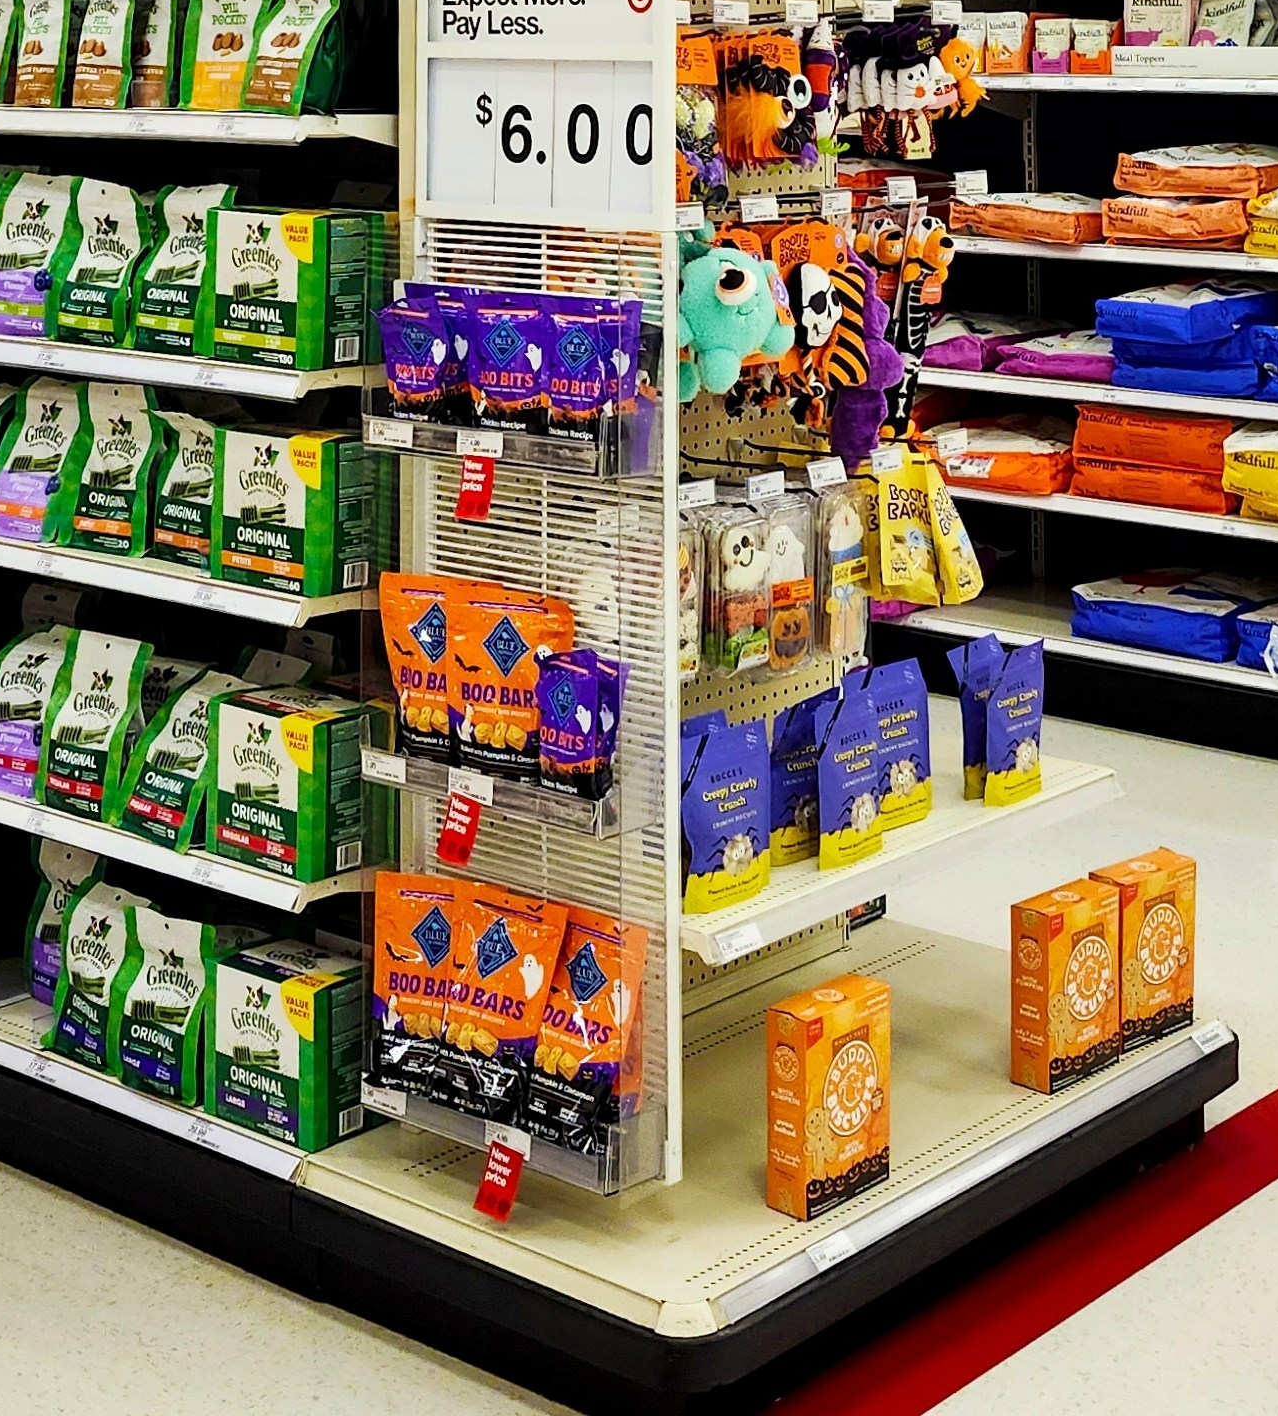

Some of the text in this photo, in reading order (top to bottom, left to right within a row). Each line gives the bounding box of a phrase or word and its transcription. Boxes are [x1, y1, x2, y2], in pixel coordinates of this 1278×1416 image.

[442, 12, 544, 41] Pay Less.
[1114, 53, 1165, 66] Meal Toppers
[6, 222, 56, 244] Greenies
[285, 224, 308, 234] VALUE
[288, 235, 309, 244] PACK!
[232, 246, 282, 273] Greenies
[70, 288, 107, 303] ORIGINAL
[147, 287, 189, 303] ORIGINAL
[229, 304, 282, 324] ORIGINAL
[279, 353, 293, 365] 130
[500, 372, 534, 387] BITS
[25, 425, 67, 447] Greenies
[97, 438, 141, 458] Greenies
[293, 449, 316, 460] VALUE
[465, 460, 483, 471] New
[239, 469, 289, 497] Greenies
[463, 471, 486, 482] lower
[461, 482, 483, 493] price
[163, 503, 201, 523] ORIGINAL
[236, 526, 290, 549] ORIGINAL
[288, 580, 300, 591] 60
[1, 670, 46, 694] Greenies
[462, 681, 538, 709] BOO BAR
[74, 692, 120, 718] Greenies
[892, 709, 918, 725] Crawly
[285, 729, 308, 742] VALUE
[882, 725, 908, 740] Crunch
[289, 741, 309, 752] PACK!
[834, 747, 856, 763] Creepy
[55, 748, 97, 769] ORIGINAL
[233, 745, 282, 778] Greenies
[483, 750, 510, 762] Pumpkin
[846, 758, 871, 773] Crunch
[703, 777, 758, 802] Creepy Crawly
[90, 802, 98, 812] 12
[451, 796, 470, 813] New
[718, 795, 747, 813] Crunch
[231, 802, 283, 831] ORIGINAL
[448, 808, 472, 824] lower
[445, 819, 467, 835] price
[282, 864, 294, 875] 36
[1145, 909, 1178, 935] BUDDY
[425, 929, 448, 941] BLUE
[71, 935, 115, 969] Greenies
[1071, 942, 1107, 971] BUDDY
[147, 966, 199, 999] Greenies
[388, 971, 419, 993] BOO
[285, 995, 309, 1010] VALUE
[473, 990, 525, 1020] BARS
[232, 1007, 282, 1043] Greenies
[131, 1025, 174, 1052] ORIGINAL
[830, 1047, 871, 1083] BUDDY
[230, 1066, 284, 1098] ORIGINAL
[284, 1131, 295, 1142] 24
[490, 1146, 510, 1164] New
[487, 1158, 513, 1177] lower
[484, 1171, 507, 1188] price
